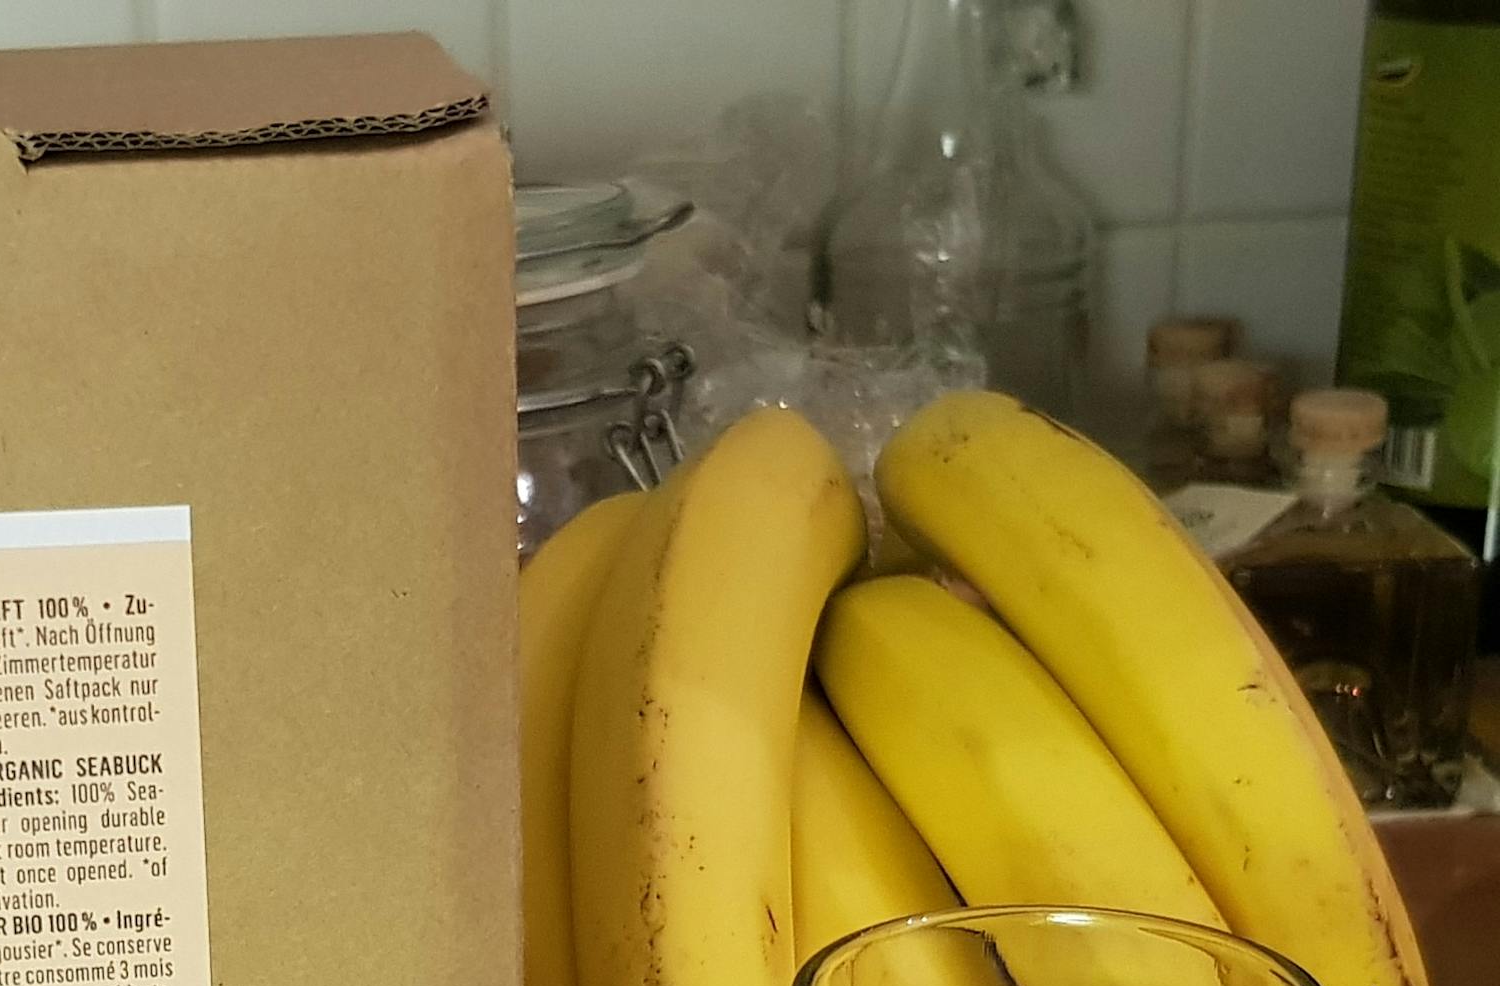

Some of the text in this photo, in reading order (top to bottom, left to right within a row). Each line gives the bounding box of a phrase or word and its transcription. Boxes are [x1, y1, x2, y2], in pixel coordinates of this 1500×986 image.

[35, 624, 79, 647] Nach
[85, 618, 155, 646] Öffnung
[44, 676, 121, 702] Saftpack
[130, 679, 158, 696] nur
[76, 753, 163, 778] SEABUCK
[71, 781, 115, 804] 100%
[21, 809, 88, 836] opening
[100, 805, 165, 829] durable
[7, 842, 50, 859] room
[56, 835, 167, 859] temperature.
[16, 866, 56, 885] once
[66, 858, 133, 885] opened.
[12, 914, 43, 935] BIO
[96, 937, 172, 956] conserve
[25, 960, 115, 985] consommé
[134, 957, 173, 979] mois
